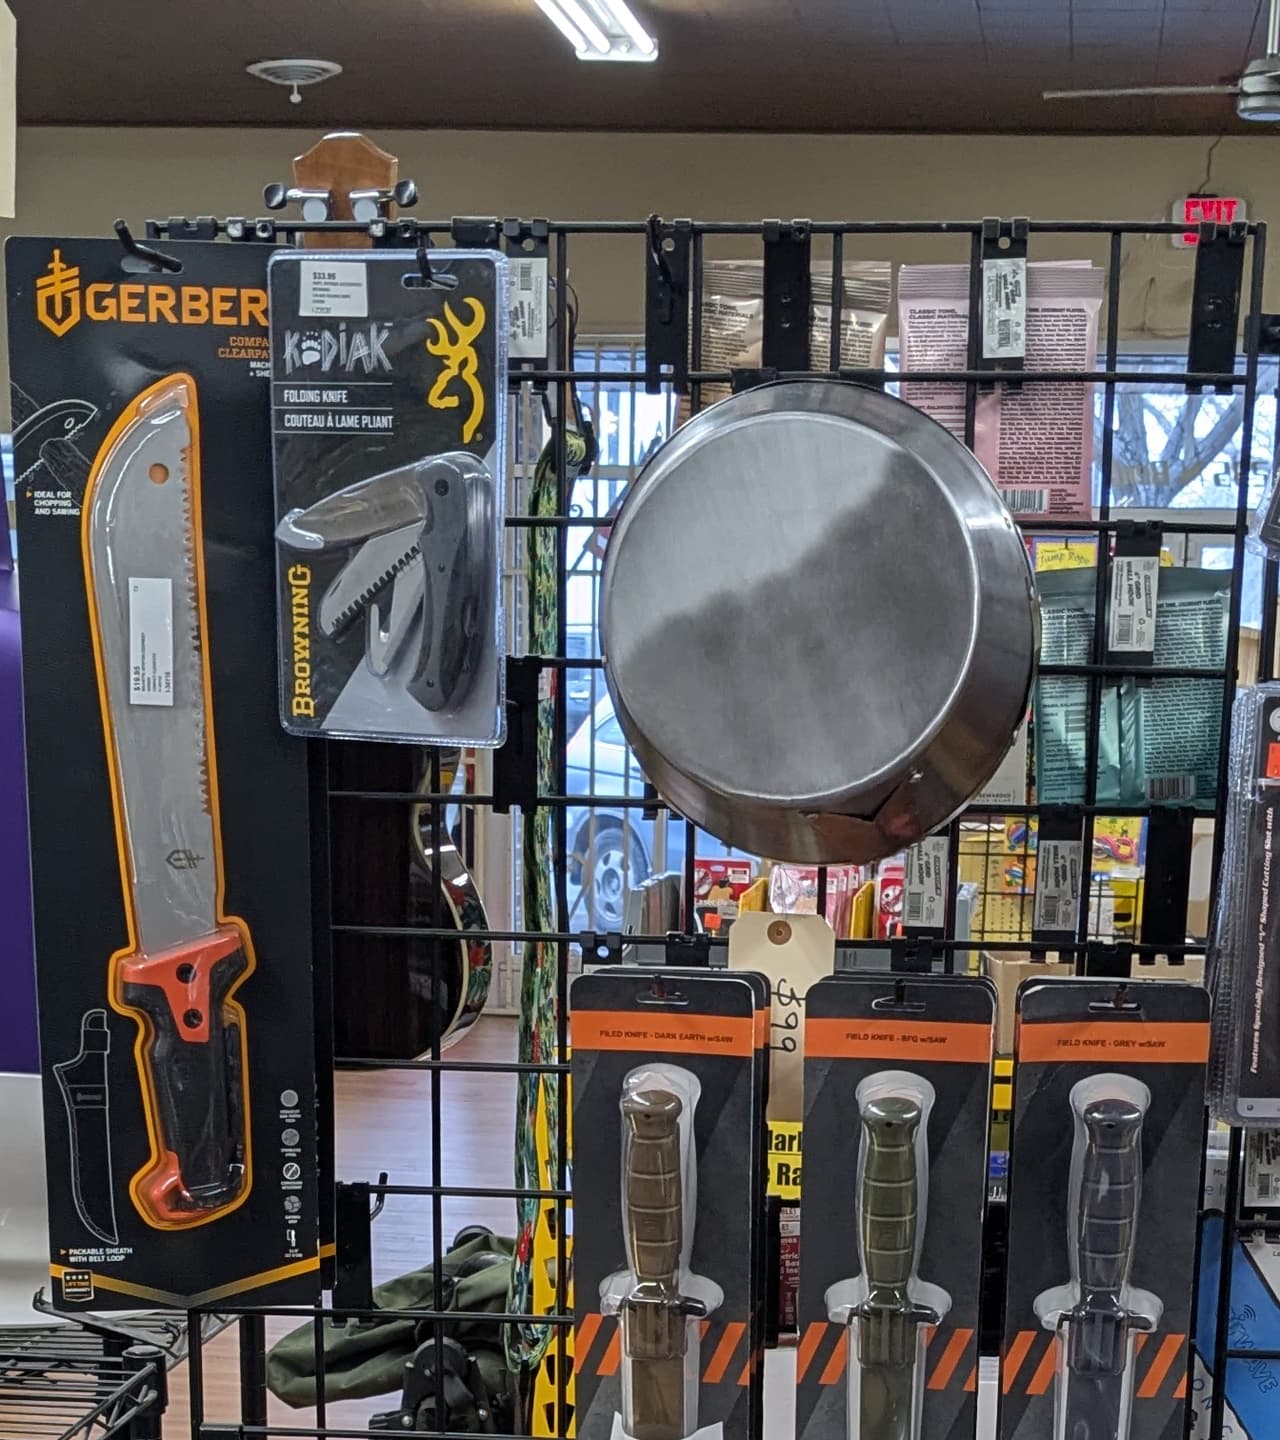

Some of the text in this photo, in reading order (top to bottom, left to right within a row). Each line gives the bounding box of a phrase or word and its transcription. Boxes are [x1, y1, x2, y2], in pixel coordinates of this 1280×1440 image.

[86, 283, 269, 326] GERBER
[284, 390, 348, 403] FOLDING KNIFE
[284, 415, 325, 428] COUTEAU
[336, 415, 360, 428] LAME
[362, 416, 393, 428] PLIANT
[287, 564, 314, 718] BROWNING
[1262, 852, 1273, 886] Cutting
[1260, 888, 1270, 924] Shaped
[1256, 943, 1266, 987] Designed
[1253, 988, 1264, 1030] Specially
[1250, 1031, 1260, 1074] Features
